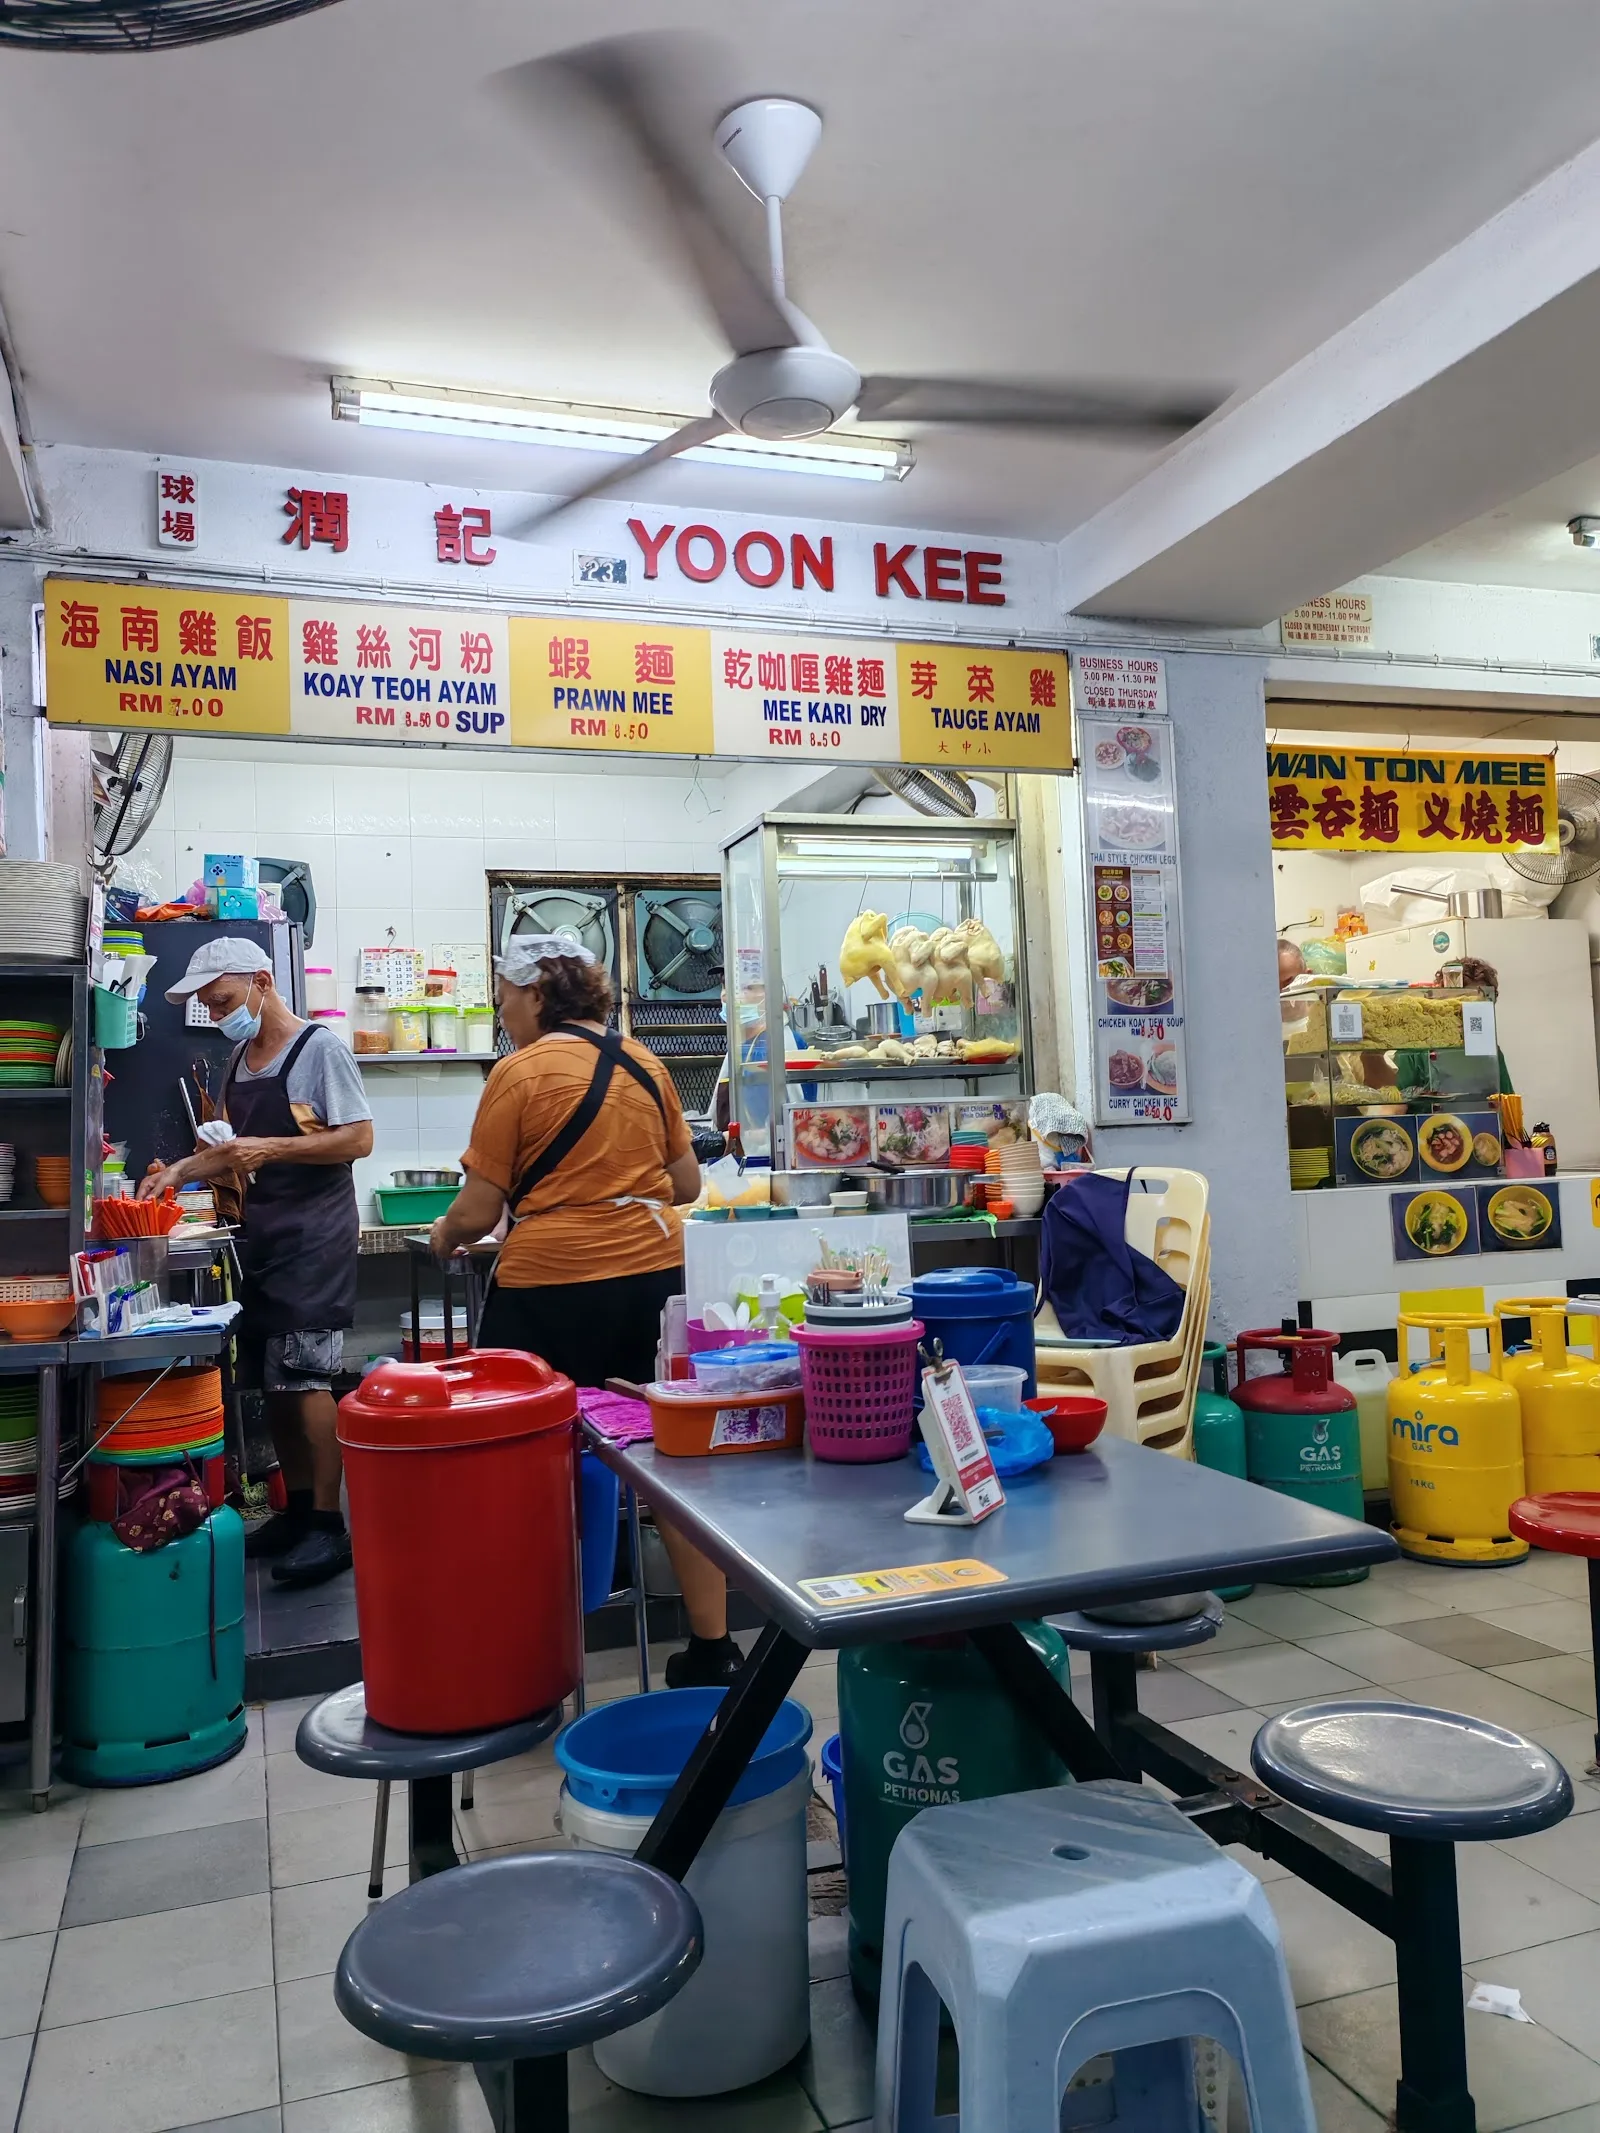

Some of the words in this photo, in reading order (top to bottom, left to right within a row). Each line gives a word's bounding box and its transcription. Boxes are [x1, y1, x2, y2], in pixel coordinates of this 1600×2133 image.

[161, 474, 195, 542] 球場
[583, 559, 614, 582] 23
[626, 518, 835, 592] YOON
[873, 542, 1006, 606] KEE
[1302, 597, 1331, 609] INESS
[1335, 598, 1366, 610] HOURS
[60, 600, 274, 661] 海南雞飯
[1285, 621, 1303, 630] CLOSED
[1304, 622, 1312, 630] ON
[1313, 623, 1340, 633] WEDNESDAY
[1347, 625, 1371, 634] THURSDAY
[302, 620, 494, 675] 雞絲河粉
[105, 658, 162, 687] NASI
[170, 663, 237, 691] AYAM
[723, 647, 887, 698] 乾咖喱雞麵
[1080, 656, 1123, 670] BUSINESS
[1127, 660, 1159, 672] HOURS
[303, 671, 365, 699] KOAY
[371, 676, 431, 702] TEOH
[438, 680, 497, 706] AYAM
[1084, 671, 1100, 681] 5.00
[1102, 672, 1115, 682] PM
[1122, 674, 1142, 684] 11.30
[1143, 675, 1157, 685] PM
[119, 692, 163, 714] RM
[553, 686, 626, 713] PRAWN
[633, 691, 674, 715] MEE
[1084, 685, 1115, 697] CLOSED
[1118, 688, 1158, 699] THURSDAY
[356, 706, 396, 726] RM
[455, 710, 505, 734] SUP
[763, 699, 803, 722] MEE
[808, 701, 852, 725] KARI
[861, 705, 887, 727] DRY
[931, 707, 989, 731] TAUGE
[994, 711, 1041, 733] AYAM
[570, 717, 607, 736] RM
[614, 722, 649, 740] 8.50
[769, 728, 802, 745] RM
[810, 730, 841, 747] 8.50
[1267, 751, 1346, 780] WAN
[1354, 756, 1445, 784] TON
[1454, 760, 1546, 786] MEE
[1090, 852, 1105, 862] THAI
[1107, 853, 1128, 864] STYLE
[1129, 854, 1157, 865] CHICKEN
[1159, 855, 1177, 865] LEGS
[1098, 1018, 1126, 1028] CHICKEN
[1128, 1018, 1146, 1028] KOAY
[1166, 1017, 1184, 1027] SOUP
[1108, 1099, 1131, 1109] CURRY
[1133, 1098, 1161, 1108] CHICKEN
[1163, 1097, 1178, 1107] RICE
[1392, 1410, 1459, 1446] mira
[1299, 1446, 1342, 1462] GAS
[1412, 1442, 1433, 1453] GAS
[882, 1750, 960, 1785] GAS
[883, 1781, 961, 1804] PETRONAS
